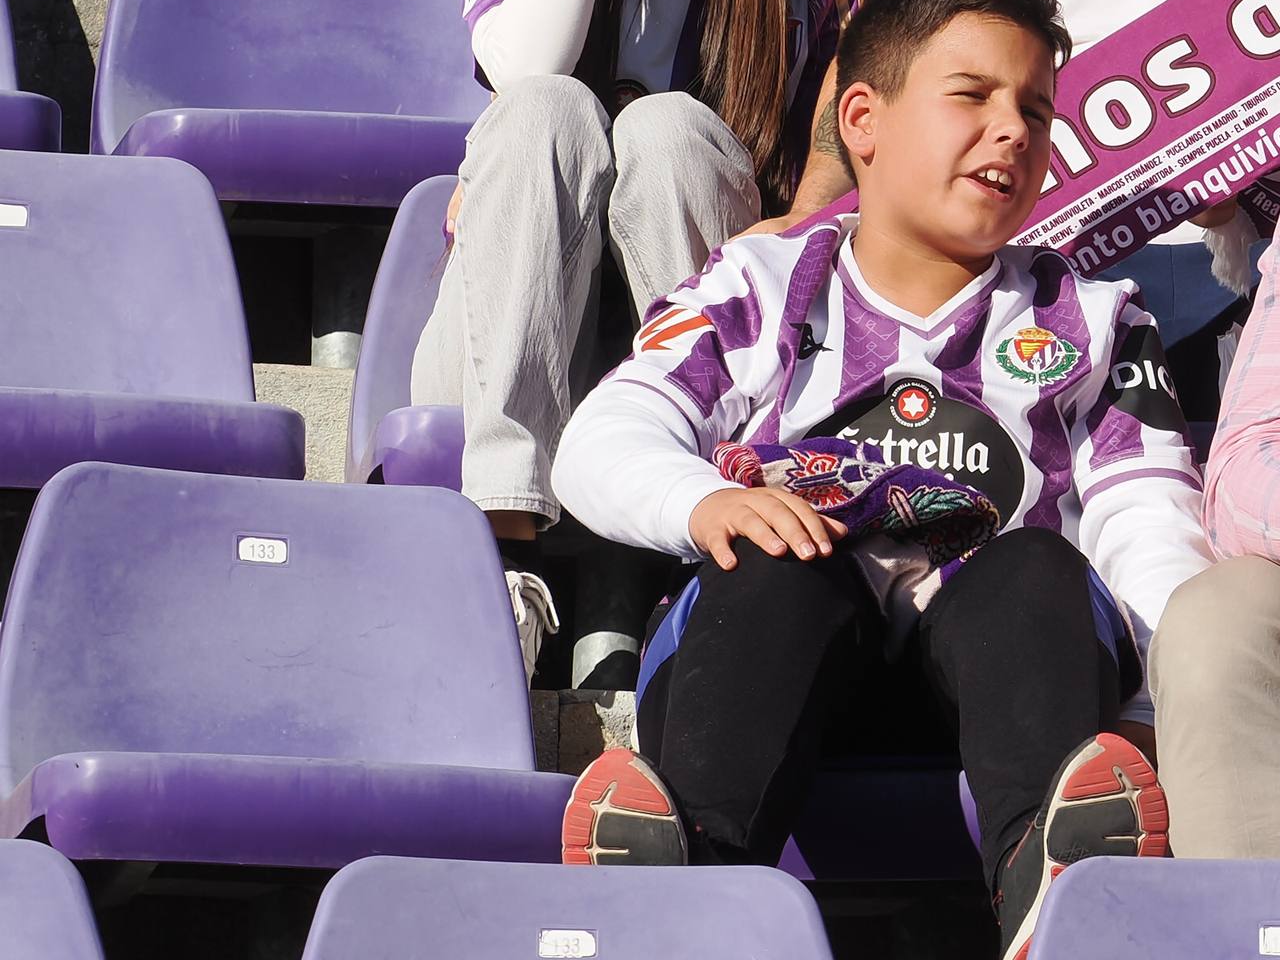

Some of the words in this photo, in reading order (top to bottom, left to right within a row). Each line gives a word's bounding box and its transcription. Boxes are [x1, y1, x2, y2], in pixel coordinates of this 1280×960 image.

[1015, 227, 1042, 248] FRENTE
[1040, 196, 1095, 233] BLANQUIVIOLETA
[1096, 177, 1125, 200] MARCOS
[1123, 154, 1163, 183] FERNÁNDEZ
[1164, 130, 1203, 158] PUCELANOS
[1201, 124, 1213, 136] EN
[1211, 109, 1238, 130] MADRID
[1240, 84, 1277, 112] TIBURONES
[1049, 224, 1074, 245] BIENVE
[1078, 208, 1103, 227] DANDO
[1100, 192, 1128, 214] GUERRA
[1130, 164, 1174, 196] LOCOMOTORA
[1176, 144, 1207, 168] SIEMPRE
[1204, 129, 1231, 150] PUCELA
[1233, 122, 1243, 133] EL
[1241, 106, 1269, 127] MOLINO
[1252, 190, 1280, 217] Rea
[249, 544, 276, 560] 133
[552, 937, 582, 955] 133
